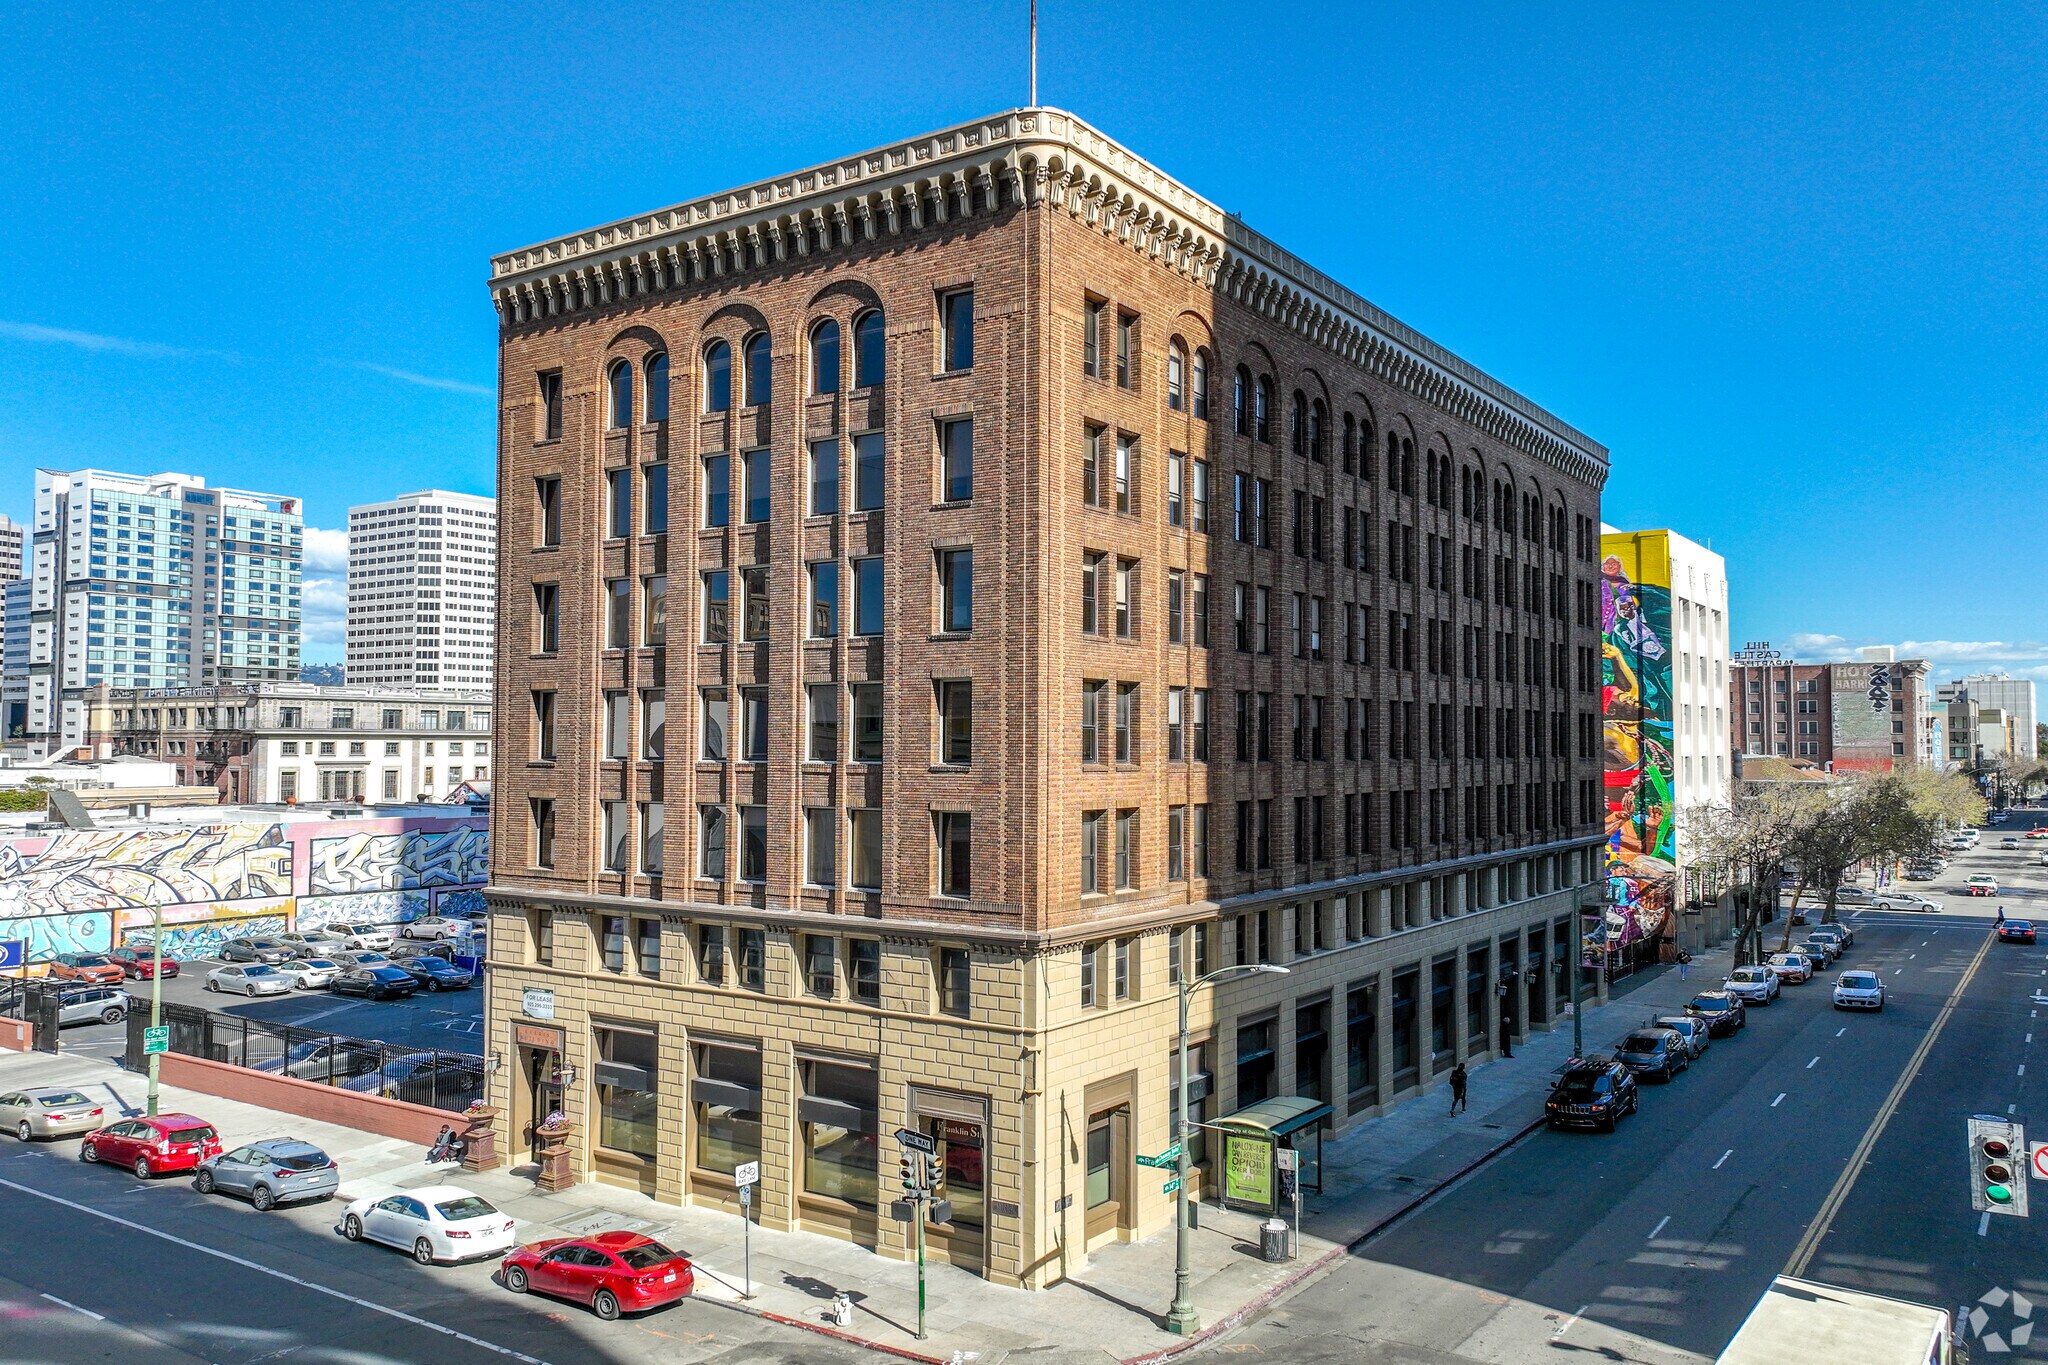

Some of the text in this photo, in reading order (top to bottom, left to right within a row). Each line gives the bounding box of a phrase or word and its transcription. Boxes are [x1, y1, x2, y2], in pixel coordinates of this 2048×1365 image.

[1836, 666, 1868, 678] HOT
[1835, 679, 1868, 689] HARRI
[537, 995, 553, 1004] LEASE
[936, 1120, 969, 1137] Franklin
[905, 1134, 929, 1148] ONE WAY
[1231, 1156, 1266, 1170] OPIOID
